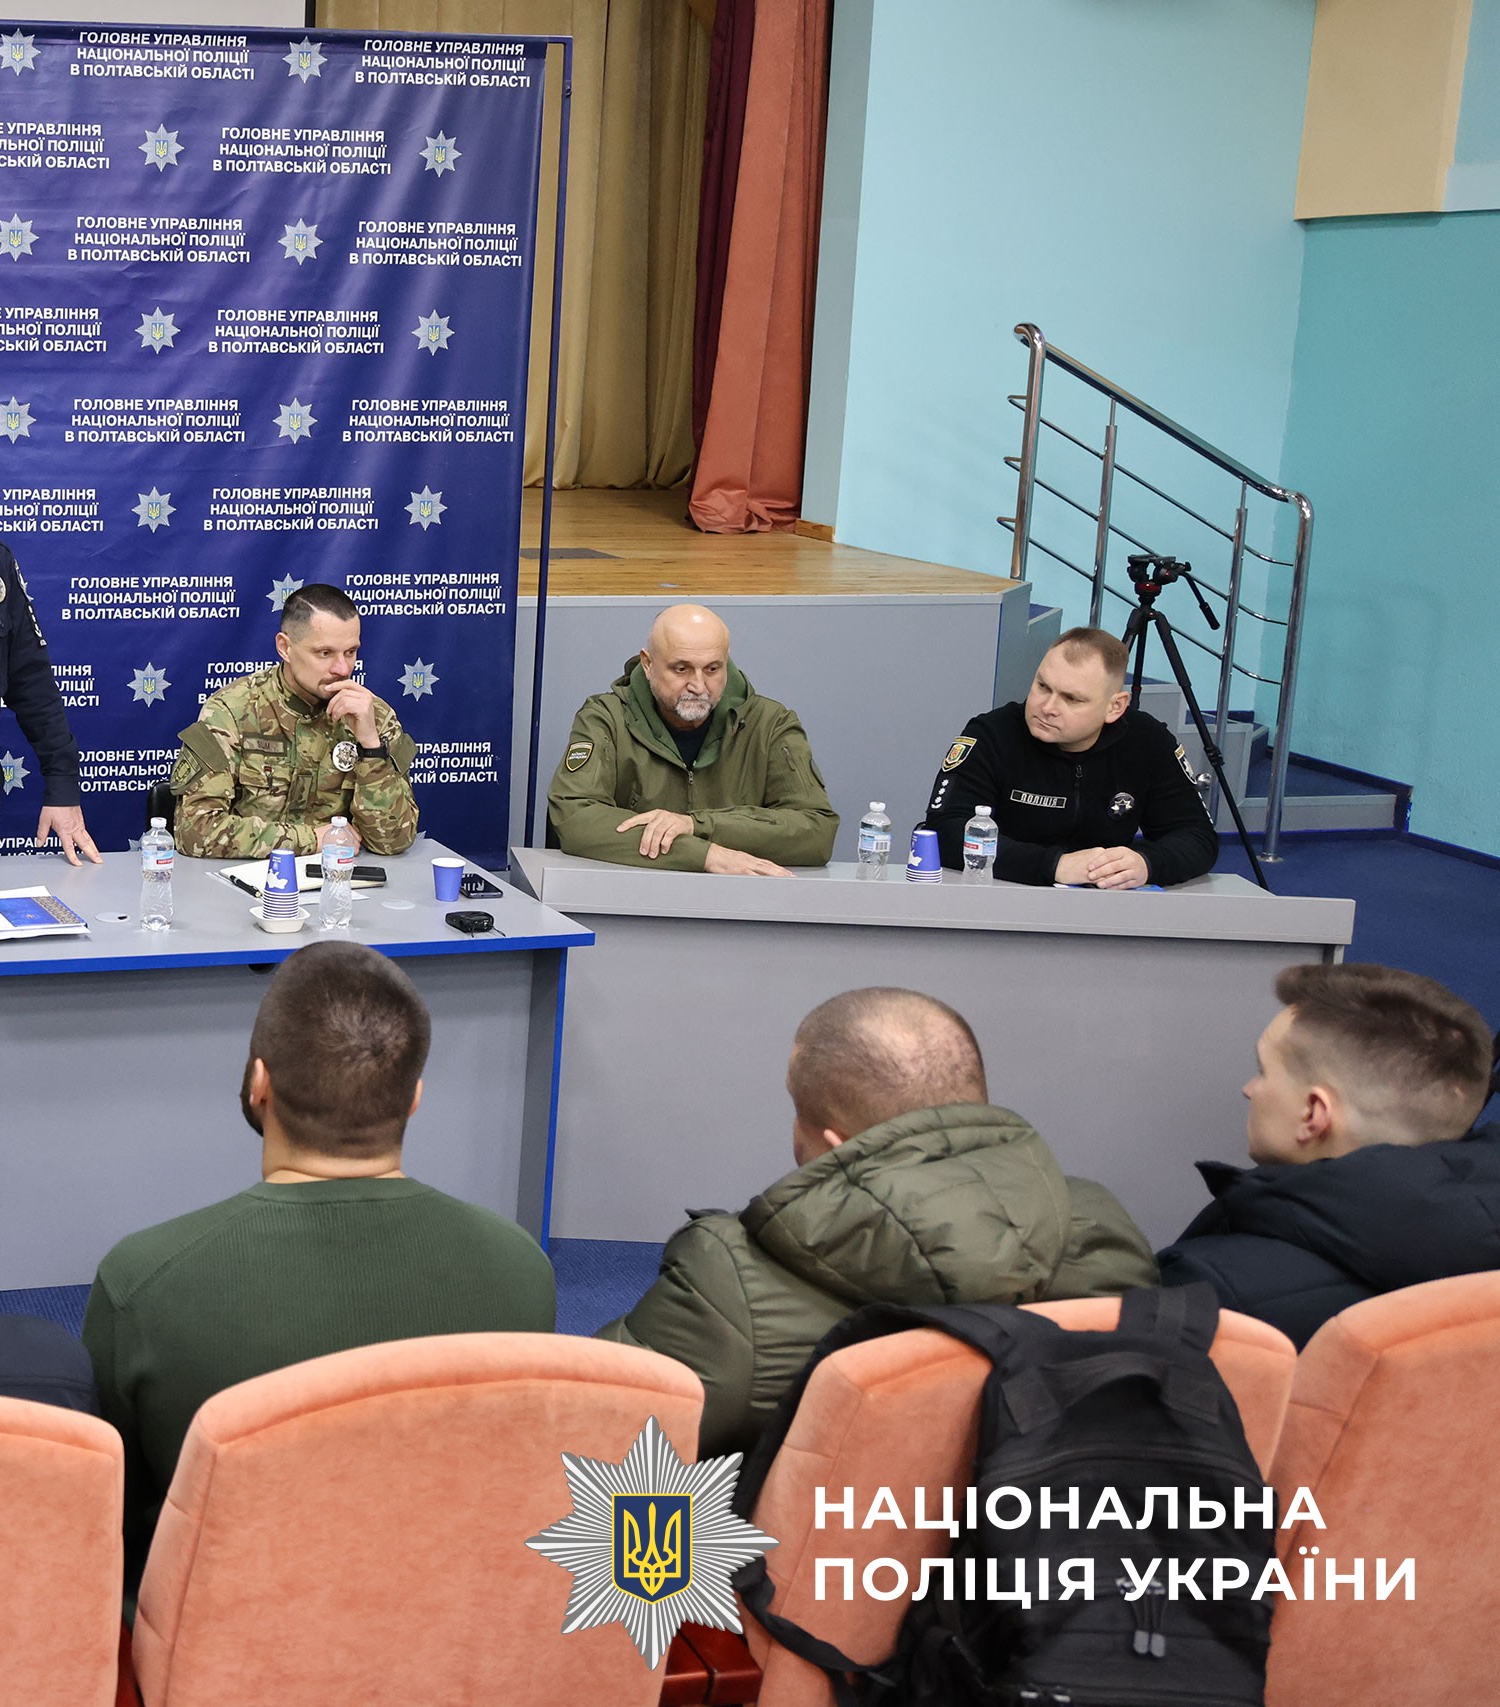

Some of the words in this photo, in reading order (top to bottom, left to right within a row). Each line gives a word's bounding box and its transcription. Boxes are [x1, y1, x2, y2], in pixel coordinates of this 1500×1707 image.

[79, 32, 150, 45] ГОЛОВНЕ
[154, 34, 247, 47] УПРАВЛІННЯ
[364, 40, 432, 52] ГОЛОВНЕ
[435, 42, 524, 55] УПРАВЛІННЯ
[77, 47, 191, 62] НАЦІОНАЛЬНОЇ
[193, 49, 250, 66] ПОЛІЦІЇ
[362, 55, 470, 70] НАЦІОНАЛЬНОЇ
[471, 57, 526, 73] ПОЛІЦІЇ
[70, 63, 80, 75] В
[84, 63, 187, 78] ПОЛТАВСЬКІЙ
[191, 66, 254, 80] ОБЛАСТІ
[355, 71, 364, 83] В
[368, 71, 466, 86] ПОЛТАВСЬКІЙ
[469, 74, 530, 87] ОБЛАСТІ
[222, 127, 291, 140] ГОЛОВНЕ
[293, 129, 384, 142] УПРАВЛІННЯ
[220, 143, 330, 158] НАЦІОНАЛЬНОЇ
[332, 144, 387, 160] ПОЛІЦІЇ
[213, 159, 222, 171] В
[226, 159, 326, 173] ПОЛТАВСЬКІЙ
[330, 162, 391, 175] ОБЛАСТІ
[77, 216, 147, 229] ГОЛОВНЕ
[150, 217, 242, 231] УПРАВЛІННЯ
[359, 221, 425, 233] ГОЛОВНЕ
[427, 222, 516, 235] УПРАВЛІННЯ
[75, 232, 187, 247] НАЦІОНАЛЬНОЇ
[189, 232, 246, 249] ПОЛІЦІЇ
[356, 236, 464, 251] НАЦІОНАЛЬНОЇ
[465, 237, 518, 253] ПОЛІЦІЇ
[68, 249, 78, 260] В
[81, 248, 183, 262] ПОЛТАВСЬКІЙ
[187, 250, 250, 263] ОБЛАСТІ
[349, 253, 359, 264] В
[362, 252, 460, 265] ПОЛТАВСЬКІЙ
[463, 254, 522, 266] ОБЛАСТІ
[218, 309, 286, 322] ГОЛОВНЕ
[289, 310, 378, 322] УПРАВЛІННЯ
[215, 324, 325, 339] НАЦІОНАЛЬНОЇ
[327, 324, 380, 340] ПОЛІЦІЇ
[208, 341, 218, 352] В
[222, 339, 321, 353] ПОЛТАВСЬКІЙ
[324, 342, 384, 354] ОБЛАСТІ
[352, 399, 419, 411] ГОЛОВНЕ
[421, 400, 507, 411] УПРАВЛІННЯ
[349, 413, 456, 428] НАЦІОНАЛЬНОЇ
[457, 413, 509, 429] ПОЛІЦІЇ
[343, 431, 352, 442] В
[355, 428, 452, 442] ПОЛТАВСЬКІЙ
[455, 431, 514, 442] ОБЛАСТІ
[2, 489, 95, 500] УПРАВЛІННЯ
[213, 488, 281, 500] ГОЛОВНЕ
[284, 487, 371, 499] УПРАВЛІННЯ
[43, 502, 99, 518] ПОЛІЦІЇ
[210, 501, 318, 517] НАЦІОНАЛЬНОЇ
[319, 501, 375, 516] ПОЛІЦІЇ
[40, 520, 103, 532] ОБЛАСТІ
[204, 520, 213, 530] В
[216, 516, 314, 531] ПОЛТАВСЬКІЙ
[317, 518, 378, 530] ОБЛАСТІ
[71, 577, 139, 589] ГОЛОВНЕ
[142, 576, 233, 588] УПРАВЛІННЯ
[346, 574, 411, 586] ГОЛОВНЕ
[414, 573, 499, 585] УПРАВЛІННЯ
[69, 589, 178, 606] НАЦІОНАЛЬНОЇ
[180, 589, 236, 605] ПОЛІЦІЇ
[344, 586, 447, 602] НАЦІОНАЛЬНОЇ
[449, 586, 501, 601] ПОЛІЦІЇ
[62, 609, 71, 620] В
[75, 605, 175, 619] ПОЛТАВСЬКІЙ
[178, 607, 240, 618] ОБЛАСТІ
[447, 603, 505, 615] ОБЛАСТІ
[79, 750, 135, 762] ОЛОВНЕ
[138, 749, 180, 761] УПРАВ
[417, 742, 491, 754] ПРАВЛІННЯ
[441, 754, 493, 769] ПОЛІЦІЇ
[79, 762, 173, 779] АЦІОНАЛЬНОЇ
[439, 771, 497, 783] ОБЛАСТІ
